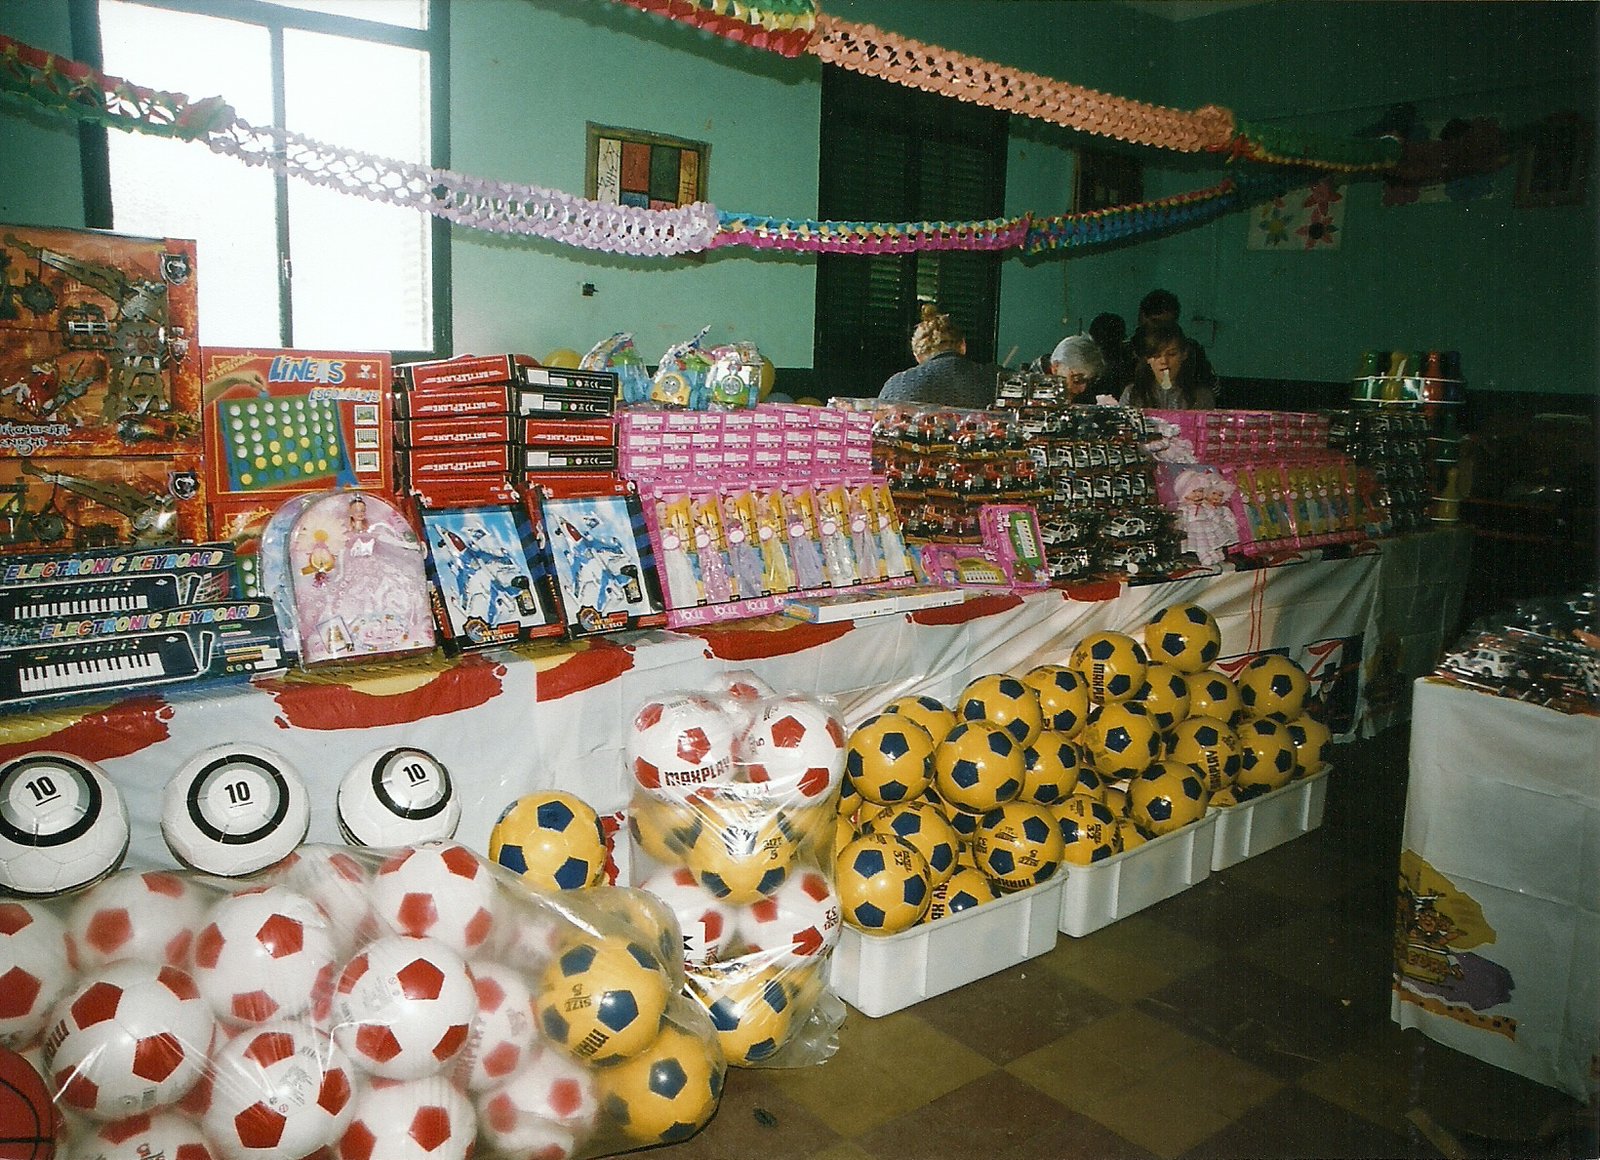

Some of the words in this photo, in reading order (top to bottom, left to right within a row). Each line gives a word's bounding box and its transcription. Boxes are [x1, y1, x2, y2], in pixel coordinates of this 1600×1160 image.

[5, 555, 126, 580] ELECTRONIC
[129, 551, 223, 571] KEYBOARD
[40, 612, 162, 639] ELECTRONIC
[166, 604, 261, 627] KEYBOARD
[402, 762, 428, 783] 10
[25, 776, 58, 801] 10
[225, 781, 251, 804] 10
